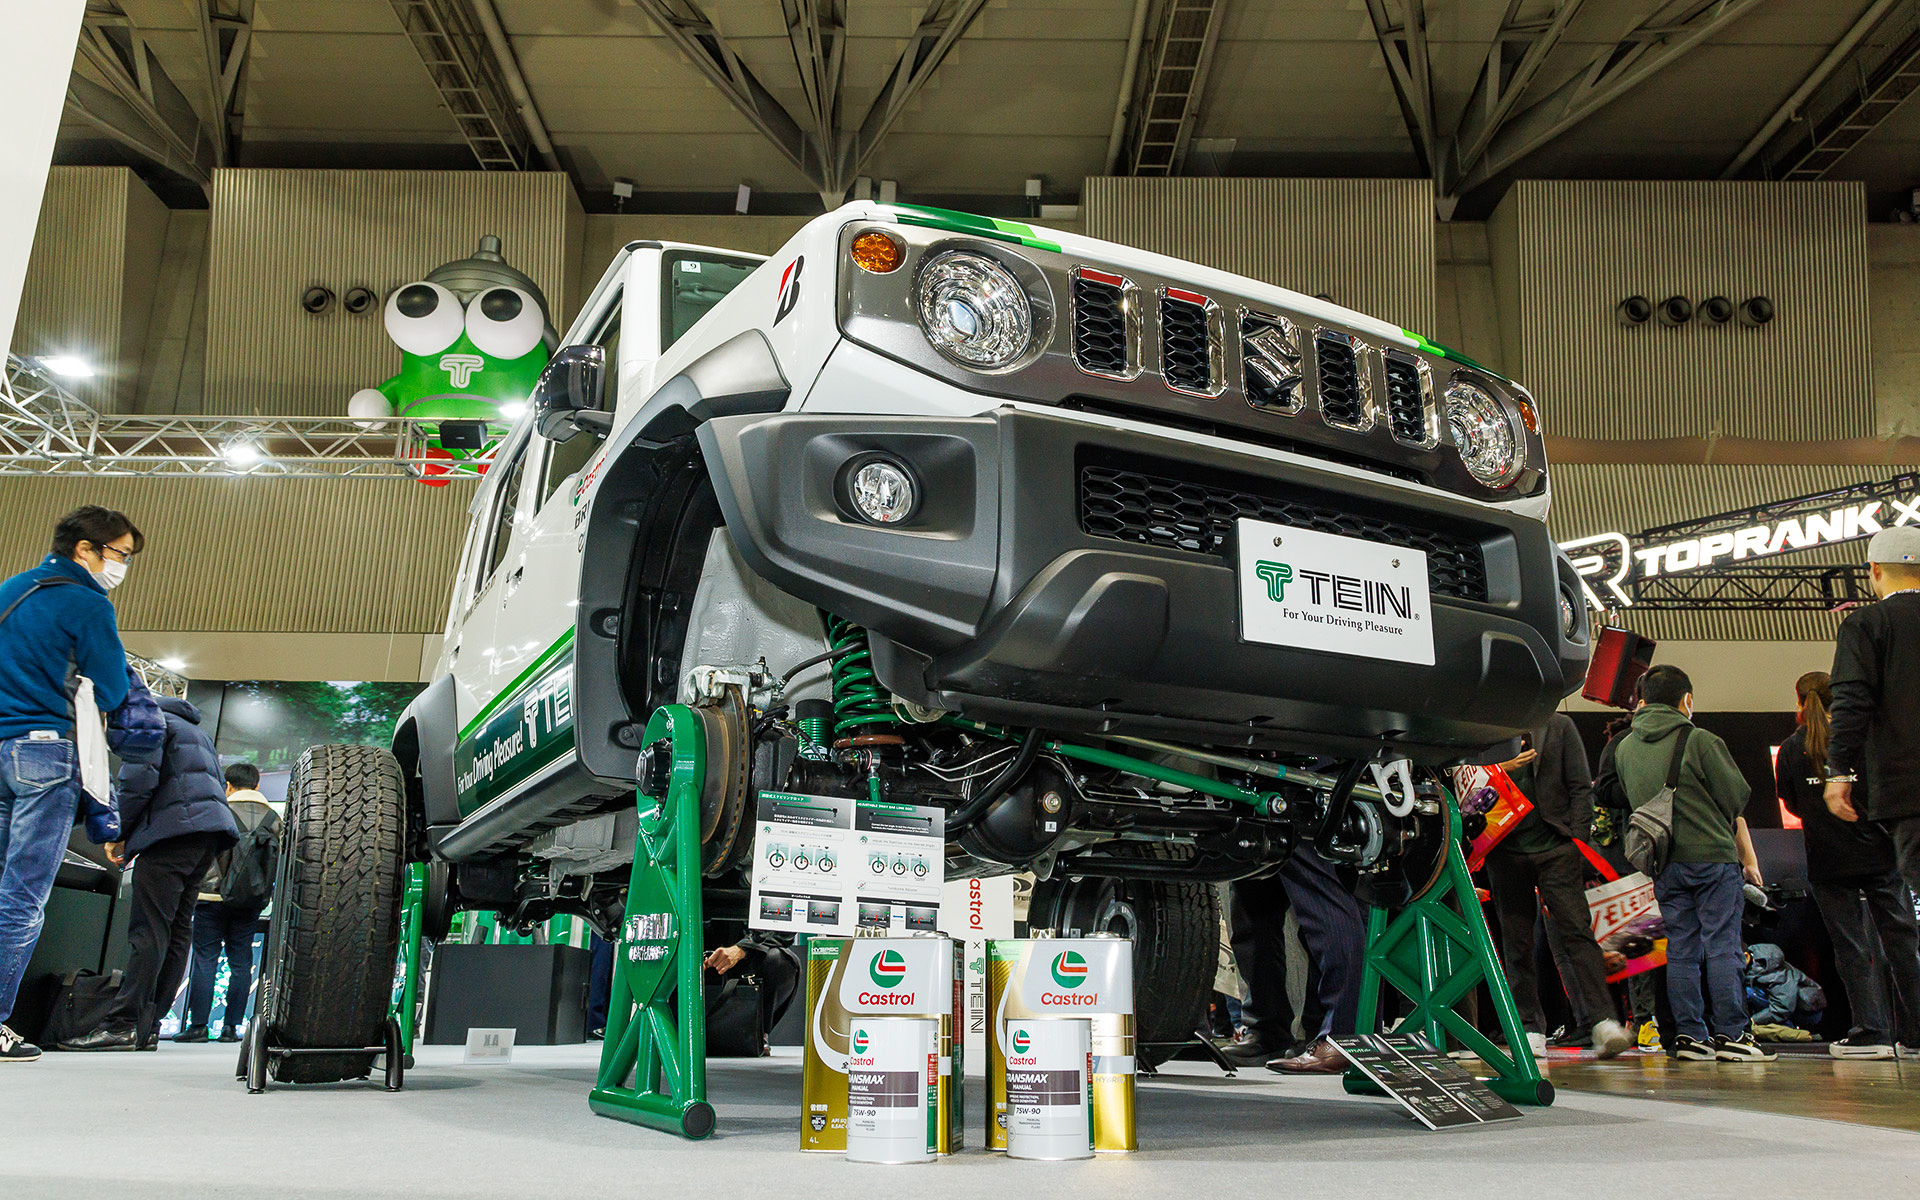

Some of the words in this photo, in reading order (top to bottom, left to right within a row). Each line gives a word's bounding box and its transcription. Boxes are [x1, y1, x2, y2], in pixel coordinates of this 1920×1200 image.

[1634, 501, 1884, 577] TOPRANK
[1299, 569, 1412, 619] TEIN
[1283, 608, 1299, 620] For
[1301, 610, 1324, 624] Your
[1326, 614, 1363, 632] Driving
[1365, 620, 1403, 635] Pleasure
[473, 749, 494, 781] Driving
[494, 720, 524, 770] Pleasure!
[858, 992, 915, 1006] Castrol
[970, 978, 984, 1034] TEIN
[1041, 992, 1098, 1006] Castrol
[850, 1057, 874, 1066] Castrol
[1009, 1056, 1037, 1066] Castrol
[1095, 1076, 1125, 1084] HYBRID
[853, 1108, 877, 1117] 75W-90
[1016, 1107, 1041, 1115] 75W-90
